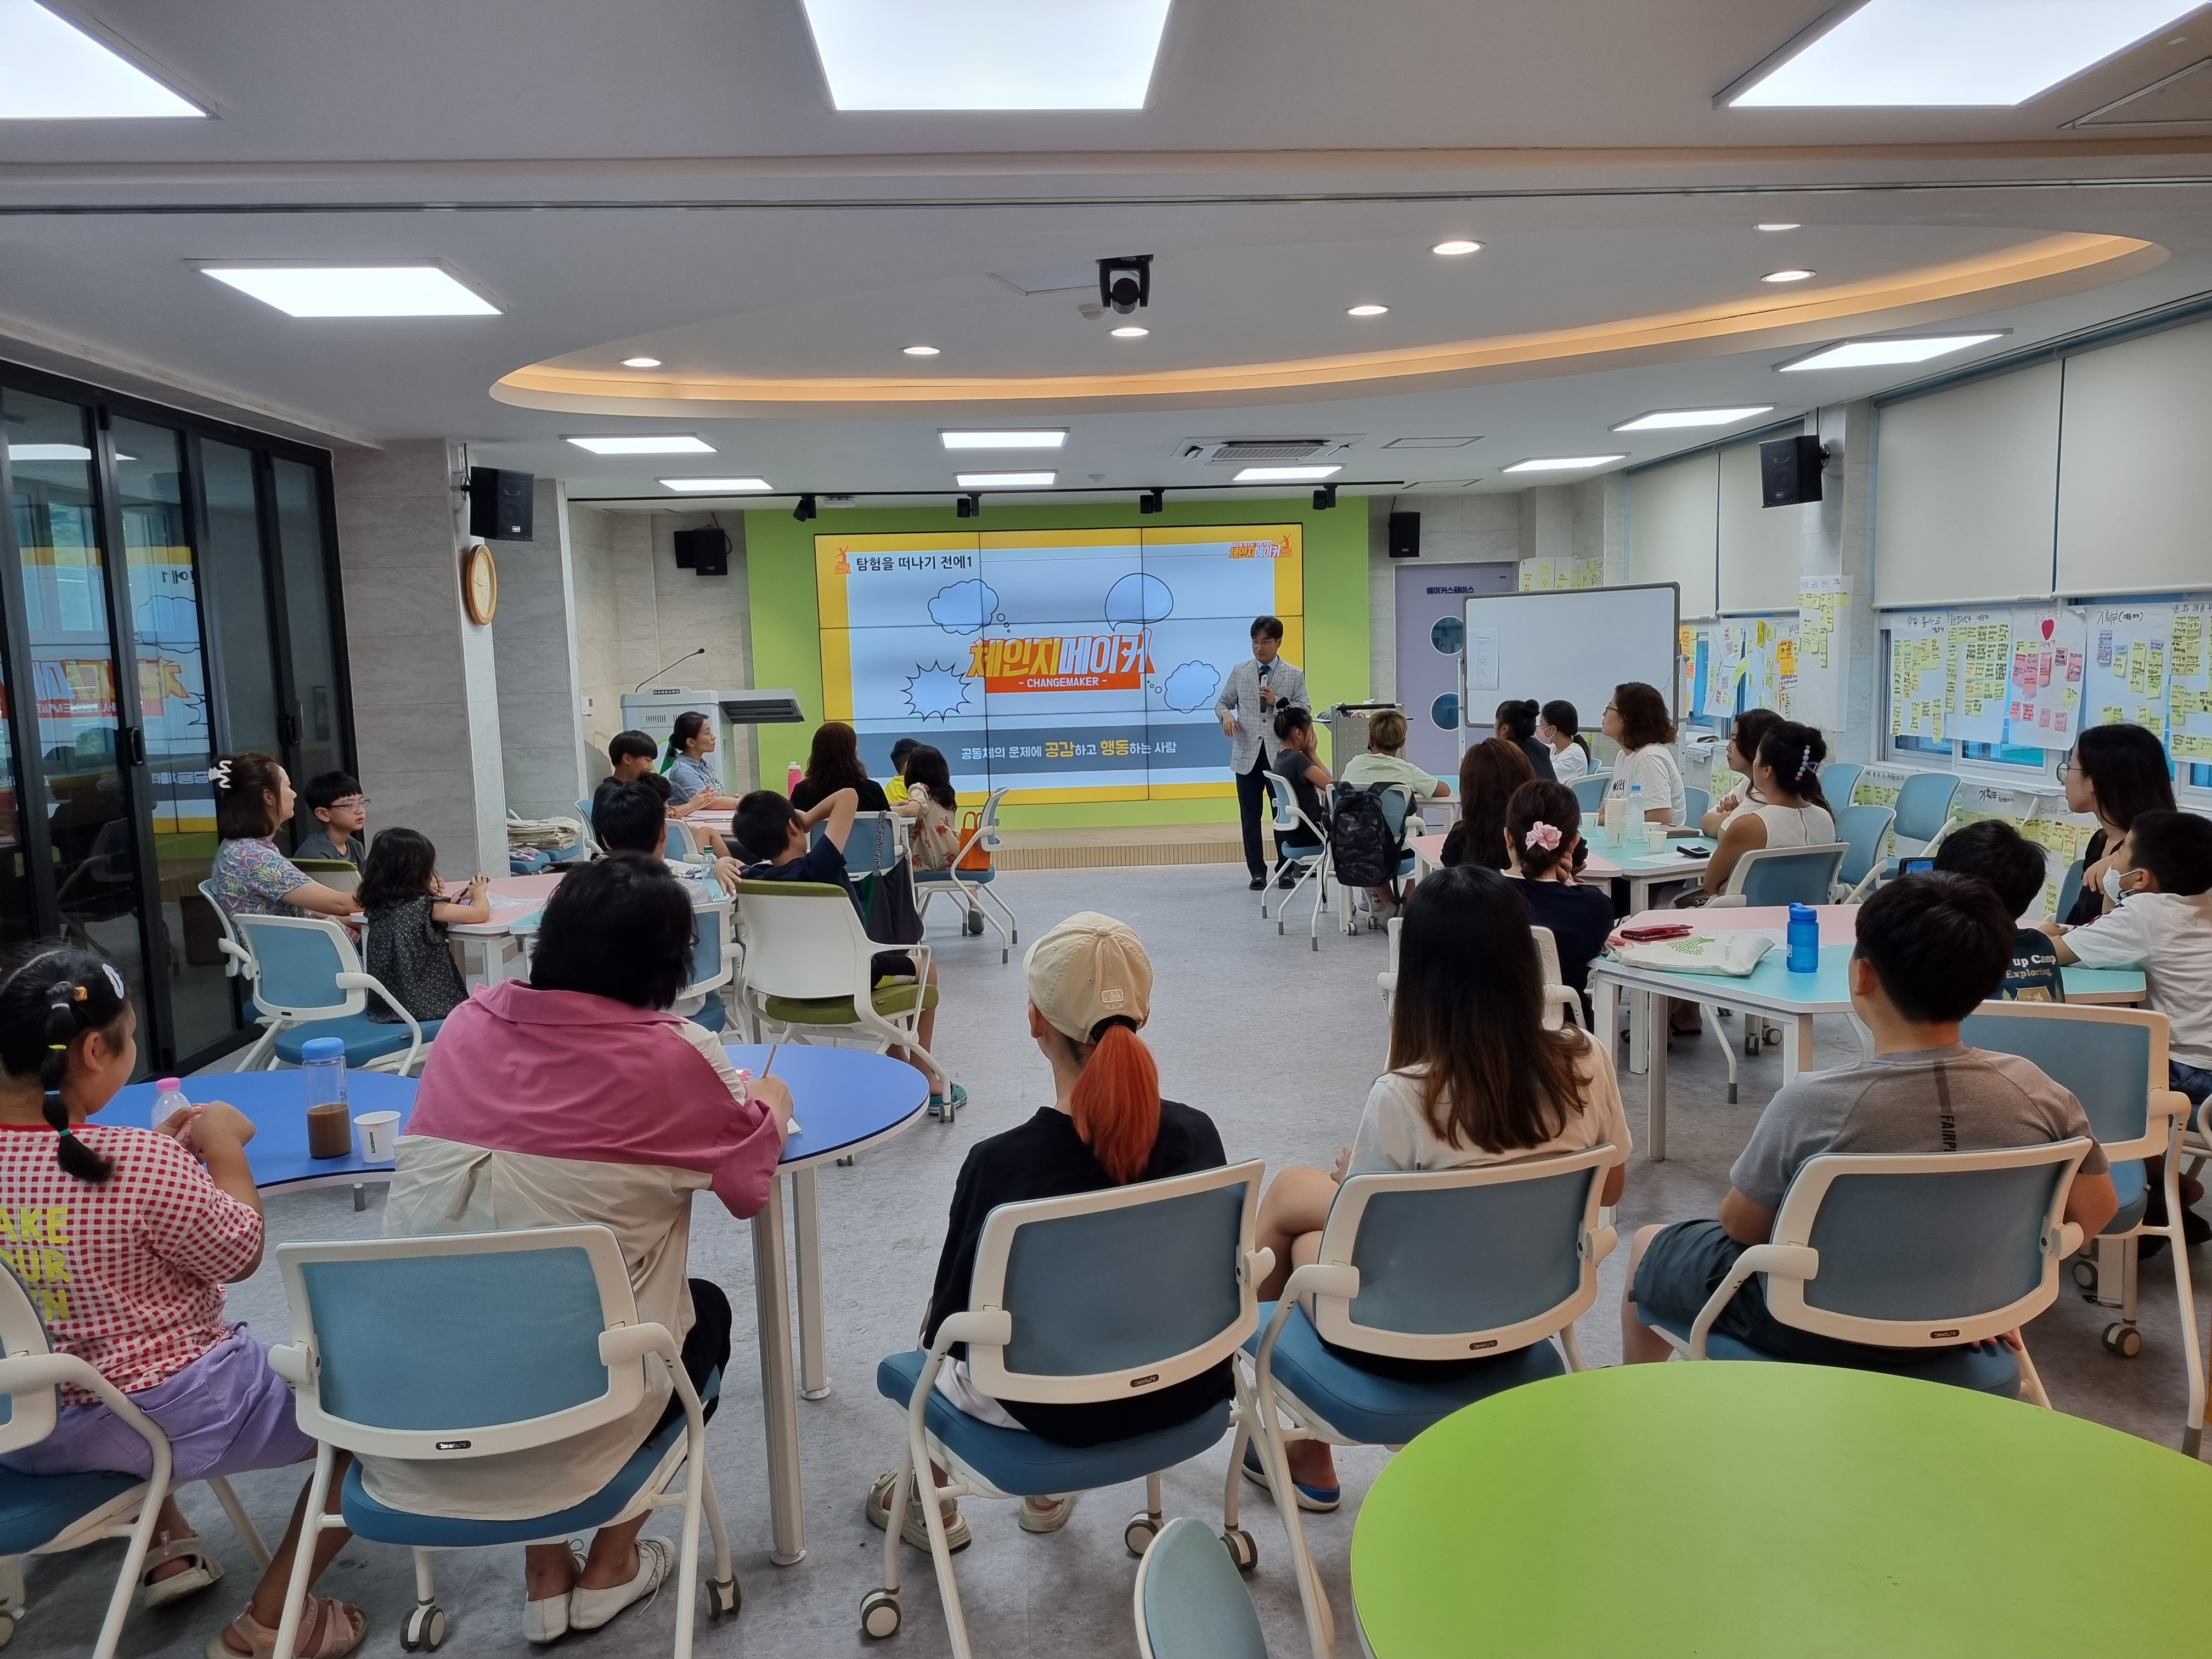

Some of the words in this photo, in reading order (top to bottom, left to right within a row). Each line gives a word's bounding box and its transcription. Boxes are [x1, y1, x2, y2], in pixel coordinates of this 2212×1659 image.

[1230, 544, 1281, 558] 체인지메이커
[856, 557, 894, 571] 탐험을
[898, 556, 936, 571] 떠나기
[940, 555, 972, 569] 전에1
[1426, 585, 1475, 595] 메이커스페이스
[966, 628, 1155, 678] 체인지메이커
[1027, 676, 1099, 688] CHANGEMAKER
[961, 747, 1006, 760] 공동체의
[1008, 746, 1042, 759] 문제에
[1045, 741, 1097, 758] 공감하고
[1100, 739, 1152, 756] 행동하는
[1154, 741, 1177, 754] 사람
[2031, 955, 2056, 965] Camp
[2006, 968, 2052, 979] Exploring
